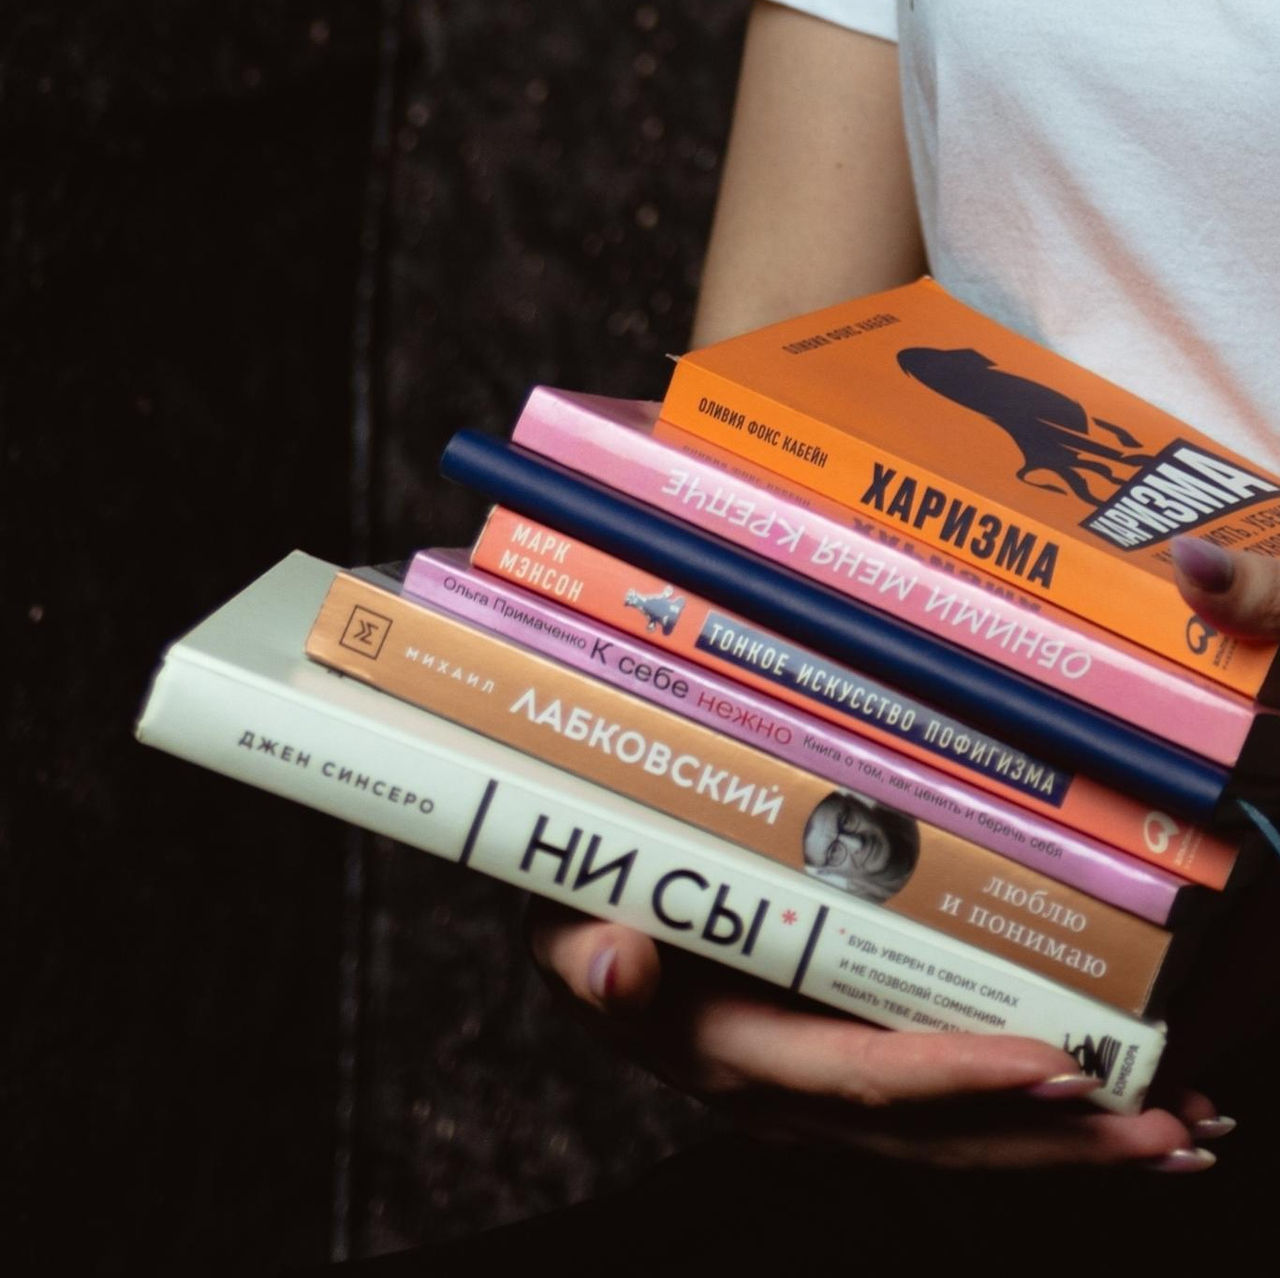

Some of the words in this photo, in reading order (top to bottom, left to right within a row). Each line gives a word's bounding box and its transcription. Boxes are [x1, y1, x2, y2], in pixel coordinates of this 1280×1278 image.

[698, 397, 745, 430] ОЛИВИЯ
[747, 420, 781, 446] ФОКС
[782, 435, 828, 468] КАБЕЙН
[661, 468, 805, 553] КРЕПЧЕ
[860, 461, 1060, 589] ХАРИЗМА
[1088, 447, 1280, 548] ХАРИЗМА
[1200, 525, 1258, 547] ИЯТЬ,
[498, 549, 584, 603] МЭНСОН
[511, 523, 572, 564] МАРК
[811, 535, 919, 601] МЕНЯ
[443, 576, 489, 606] Ольга
[493, 599, 587, 650] Примаченко
[924, 586, 1092, 679] ОБНИМИ
[590, 637, 611, 665] К
[618, 655, 690, 700] себе
[696, 691, 794, 746] нежно
[708, 622, 790, 676] ТОНКОЕ
[796, 662, 917, 732] ИСКУССТВО
[924, 719, 1057, 796] ПОФИГИЗМА
[238, 730, 312, 769] ДЖЕН
[321, 761, 435, 815] СИНСЕРО
[404, 646, 496, 695] МИХАИЛ
[509, 687, 786, 825] ЛАБКОВСКИЙ
[803, 734, 842, 762] Книга
[844, 756, 854, 768] о
[857, 761, 885, 784] том,
[888, 776, 913, 794] как
[914, 786, 962, 816] ценить
[966, 809, 975, 821] и
[977, 811, 1027, 845] беречь
[1028, 837, 1064, 860] себя
[519, 814, 639, 907] НИ
[939, 894, 963, 917] и
[967, 905, 1108, 979] понимаю
[982, 876, 1088, 933] люблю
[831, 980, 881, 1007] МЕШАТЬ
[882, 999, 911, 1020] ТЕБЕ
[839, 957, 849, 970] И
[850, 963, 868, 978] НЕ
[869, 969, 932, 1001] ПОЗВОЛЯЙ
[933, 993, 1007, 1030] СОМНЕНИЯМ
[847, 934, 879, 956] БУДЬ
[881, 945, 925, 973] УВЕРЕН
[926, 965, 936, 977] В
[937, 969, 979, 993] СВОИХ
[979, 984, 1021, 1009] СИЛАХ
[1111, 1044, 1140, 1098] БОМБОРА
